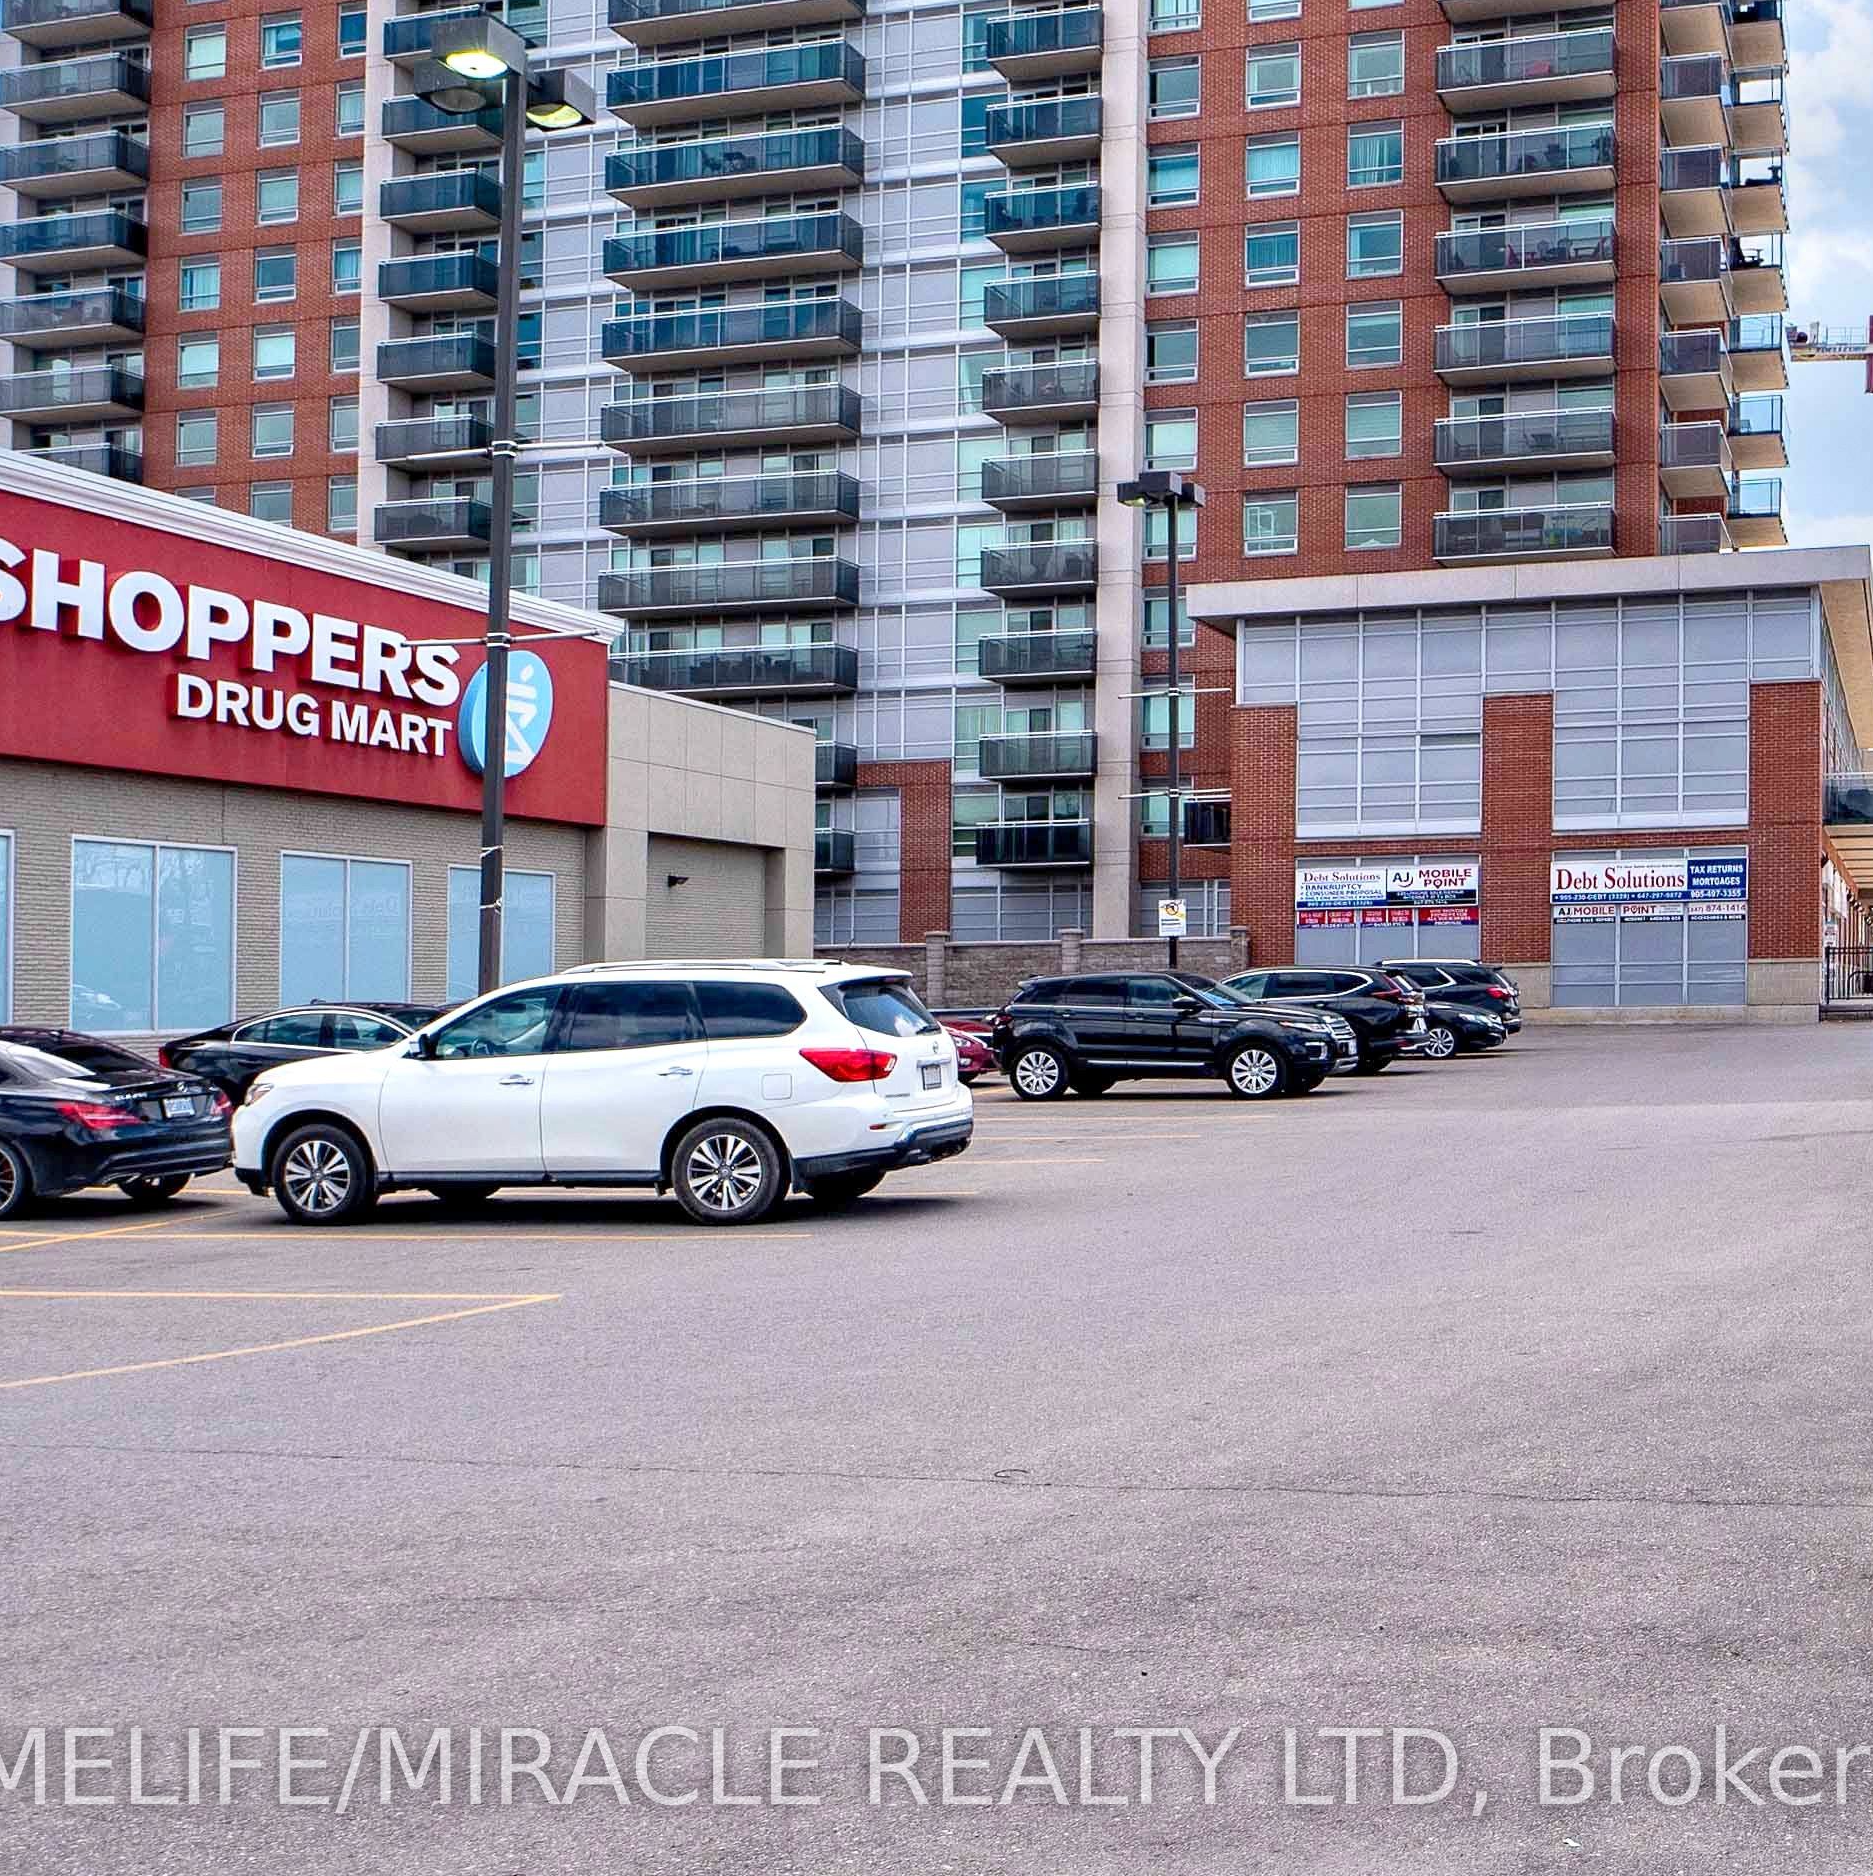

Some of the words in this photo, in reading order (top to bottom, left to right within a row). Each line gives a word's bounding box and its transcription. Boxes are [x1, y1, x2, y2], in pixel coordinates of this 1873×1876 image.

[176, 672, 320, 737] DRUG
[331, 699, 454, 757] MART
[1419, 868, 1472, 878] MOBILE
[1689, 865, 1706, 874] TAX
[1707, 864, 1744, 874] RETURNS
[1332, 871, 1382, 881] Solutions
[1556, 868, 1599, 891] Debt
[1604, 866, 1685, 890] Solutions
[1692, 877, 1741, 885] MORTGAGES
[1305, 883, 1362, 891] BANKRUPTCY
[1424, 878, 1466, 889] POINT
[1573, 906, 1615, 916] MOBILE
[1623, 905, 1658, 915] POINT
